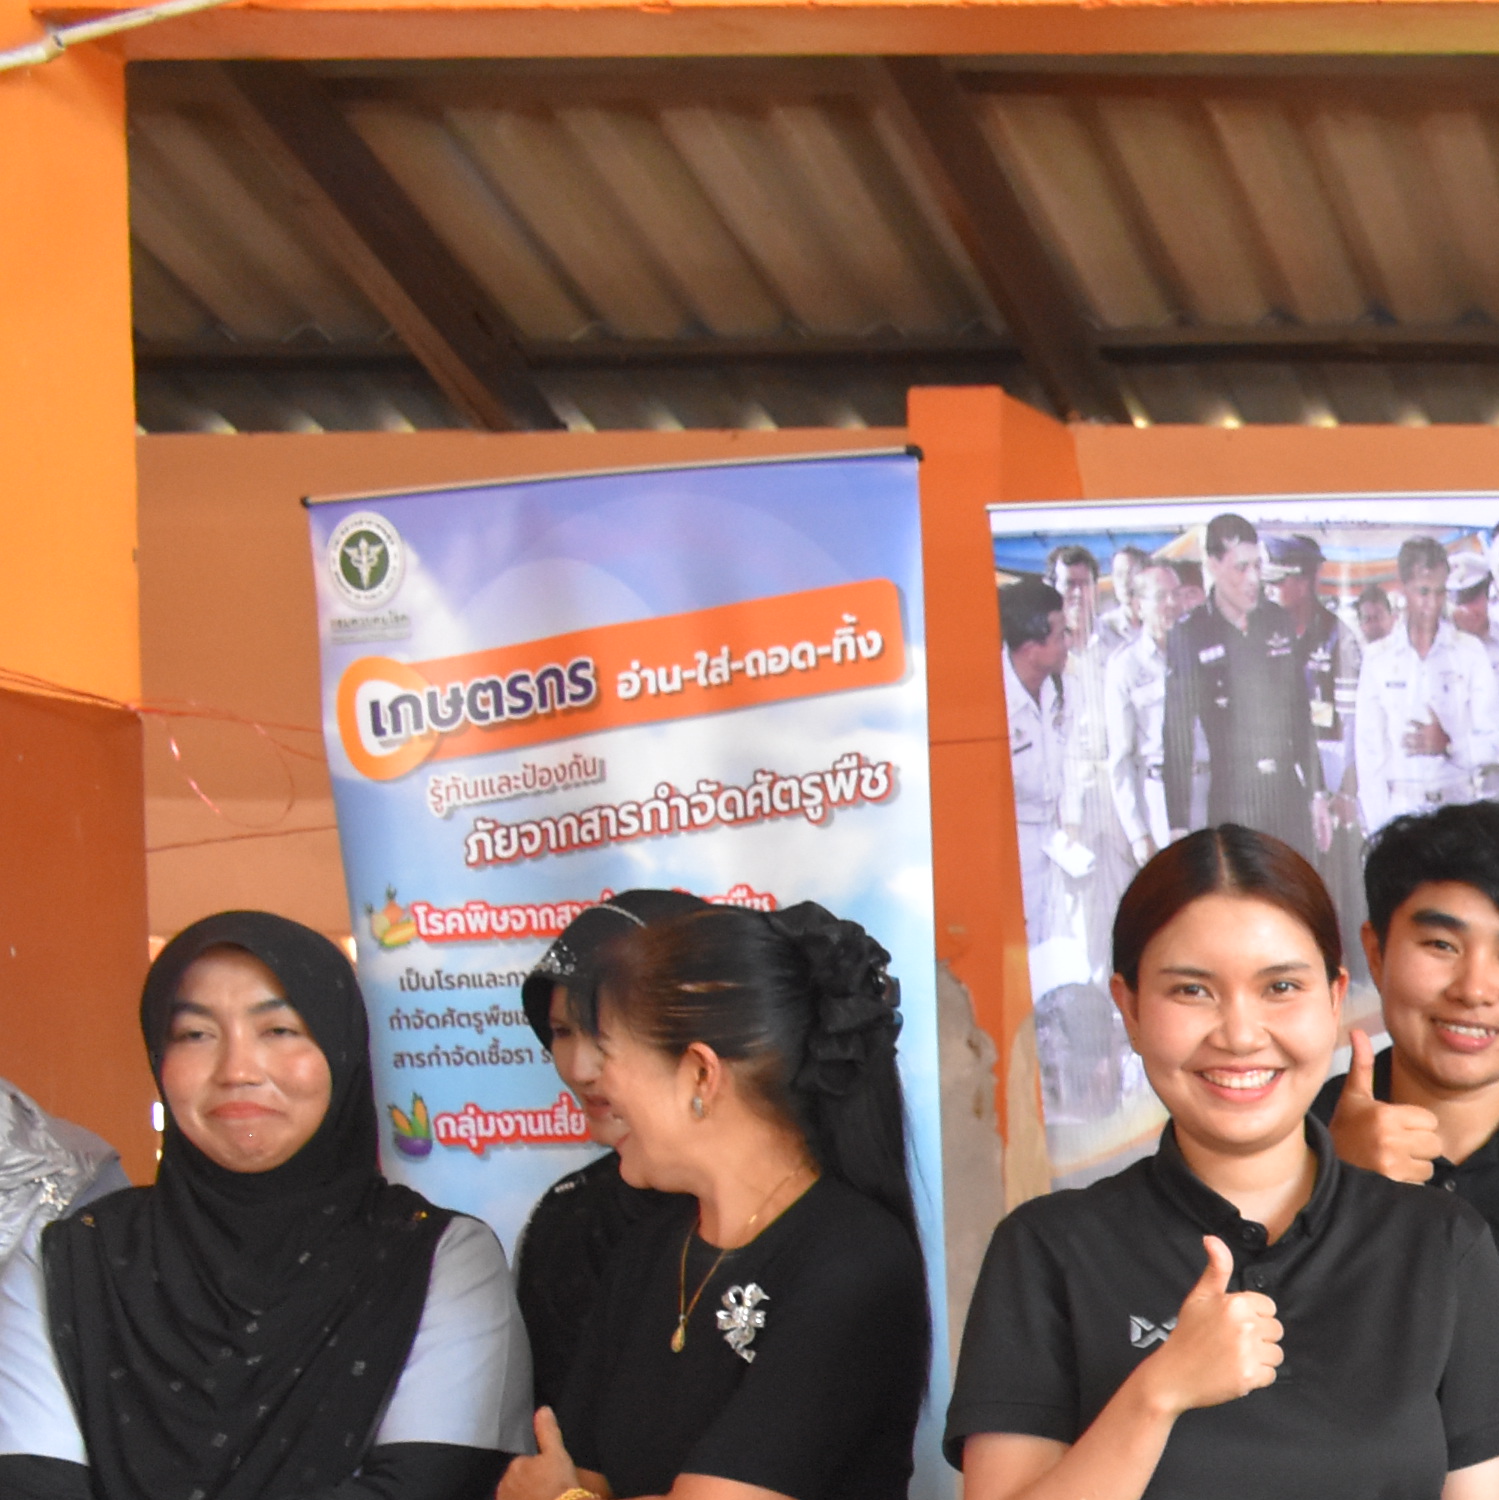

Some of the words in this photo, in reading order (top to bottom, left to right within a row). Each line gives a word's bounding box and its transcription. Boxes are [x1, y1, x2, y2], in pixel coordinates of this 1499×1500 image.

[369, 660, 594, 738] เกษตรกร
[616, 613, 883, 699] อ่าน-ใส่-ถอด-ทิ้ง
[428, 754, 600, 814] รู้ทันและป้องกัน
[465, 752, 891, 866] ภัยจากสารกำจัดศัตรูพืช
[393, 1037, 533, 1069] สารกำจัดเชื้อรา
